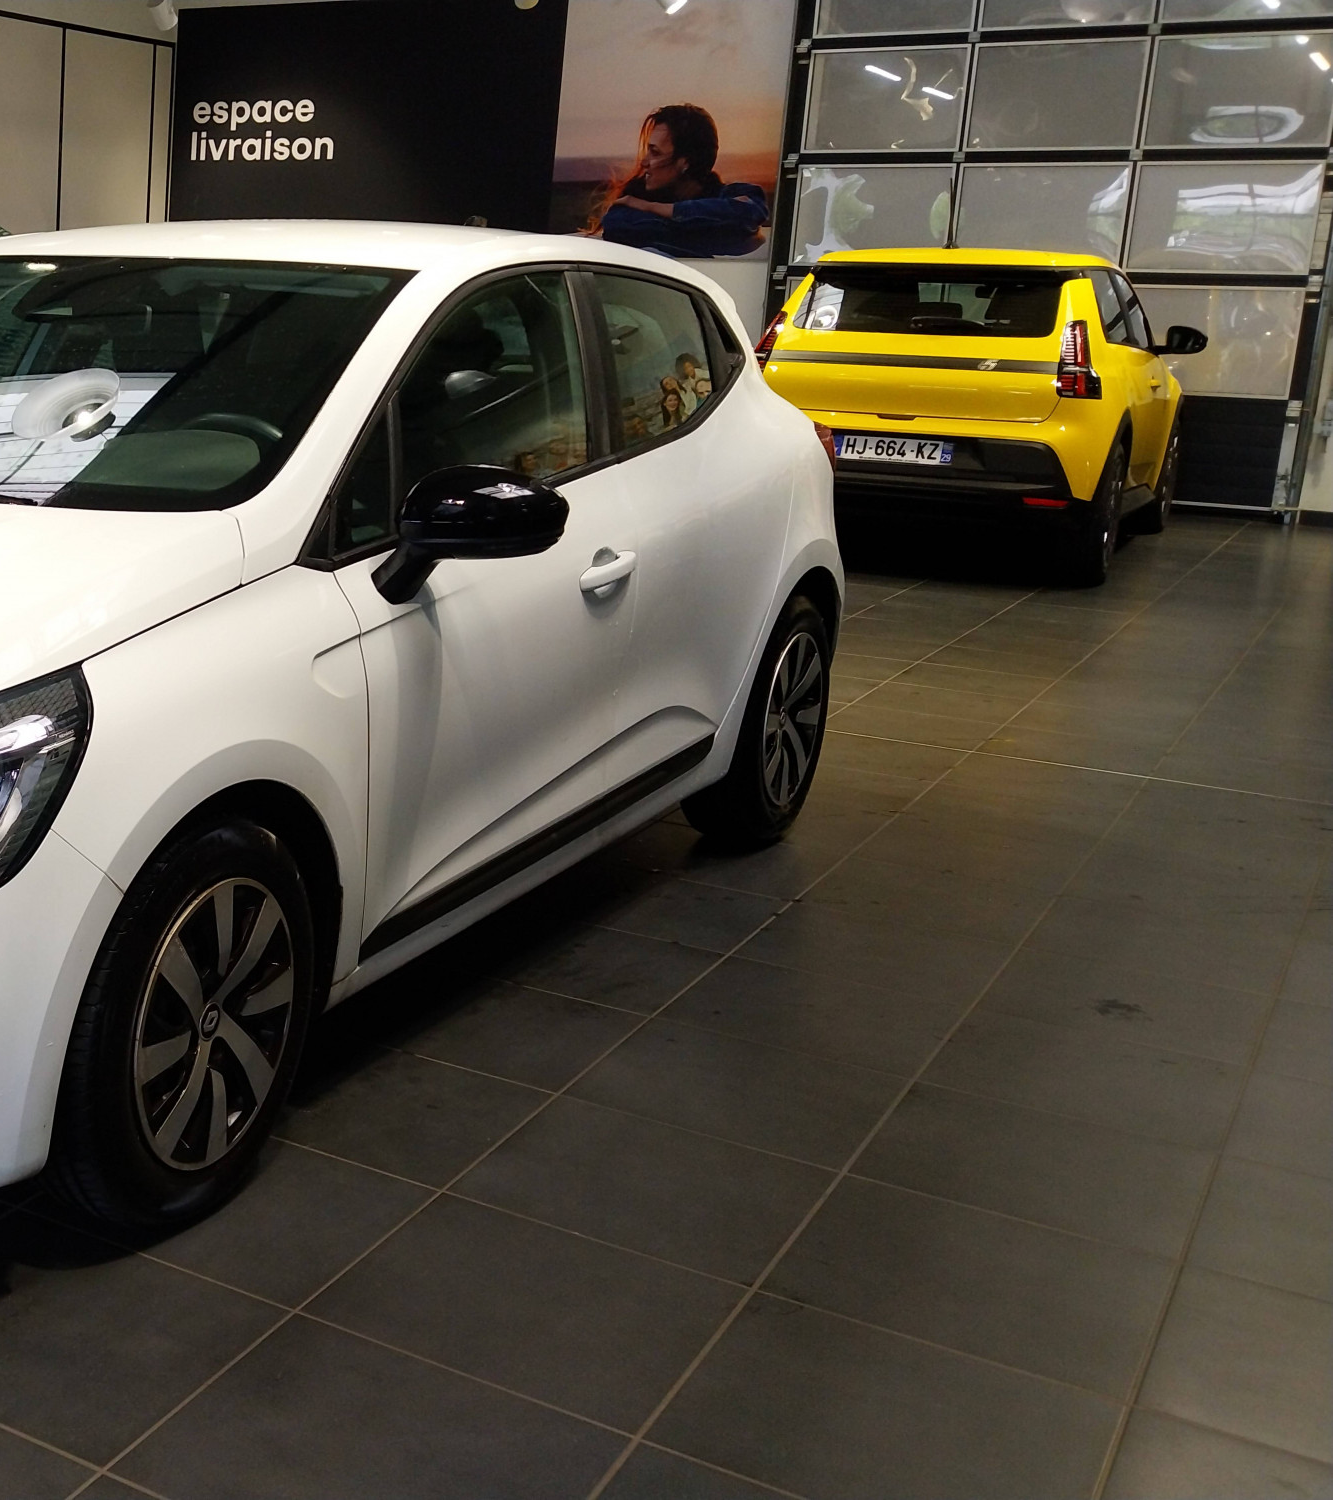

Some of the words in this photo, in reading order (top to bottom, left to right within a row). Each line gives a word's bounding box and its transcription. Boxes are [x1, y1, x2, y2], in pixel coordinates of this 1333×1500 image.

[193, 98, 315, 131] espace
[190, 130, 334, 161] livraison
[940, 453, 952, 463] 29
